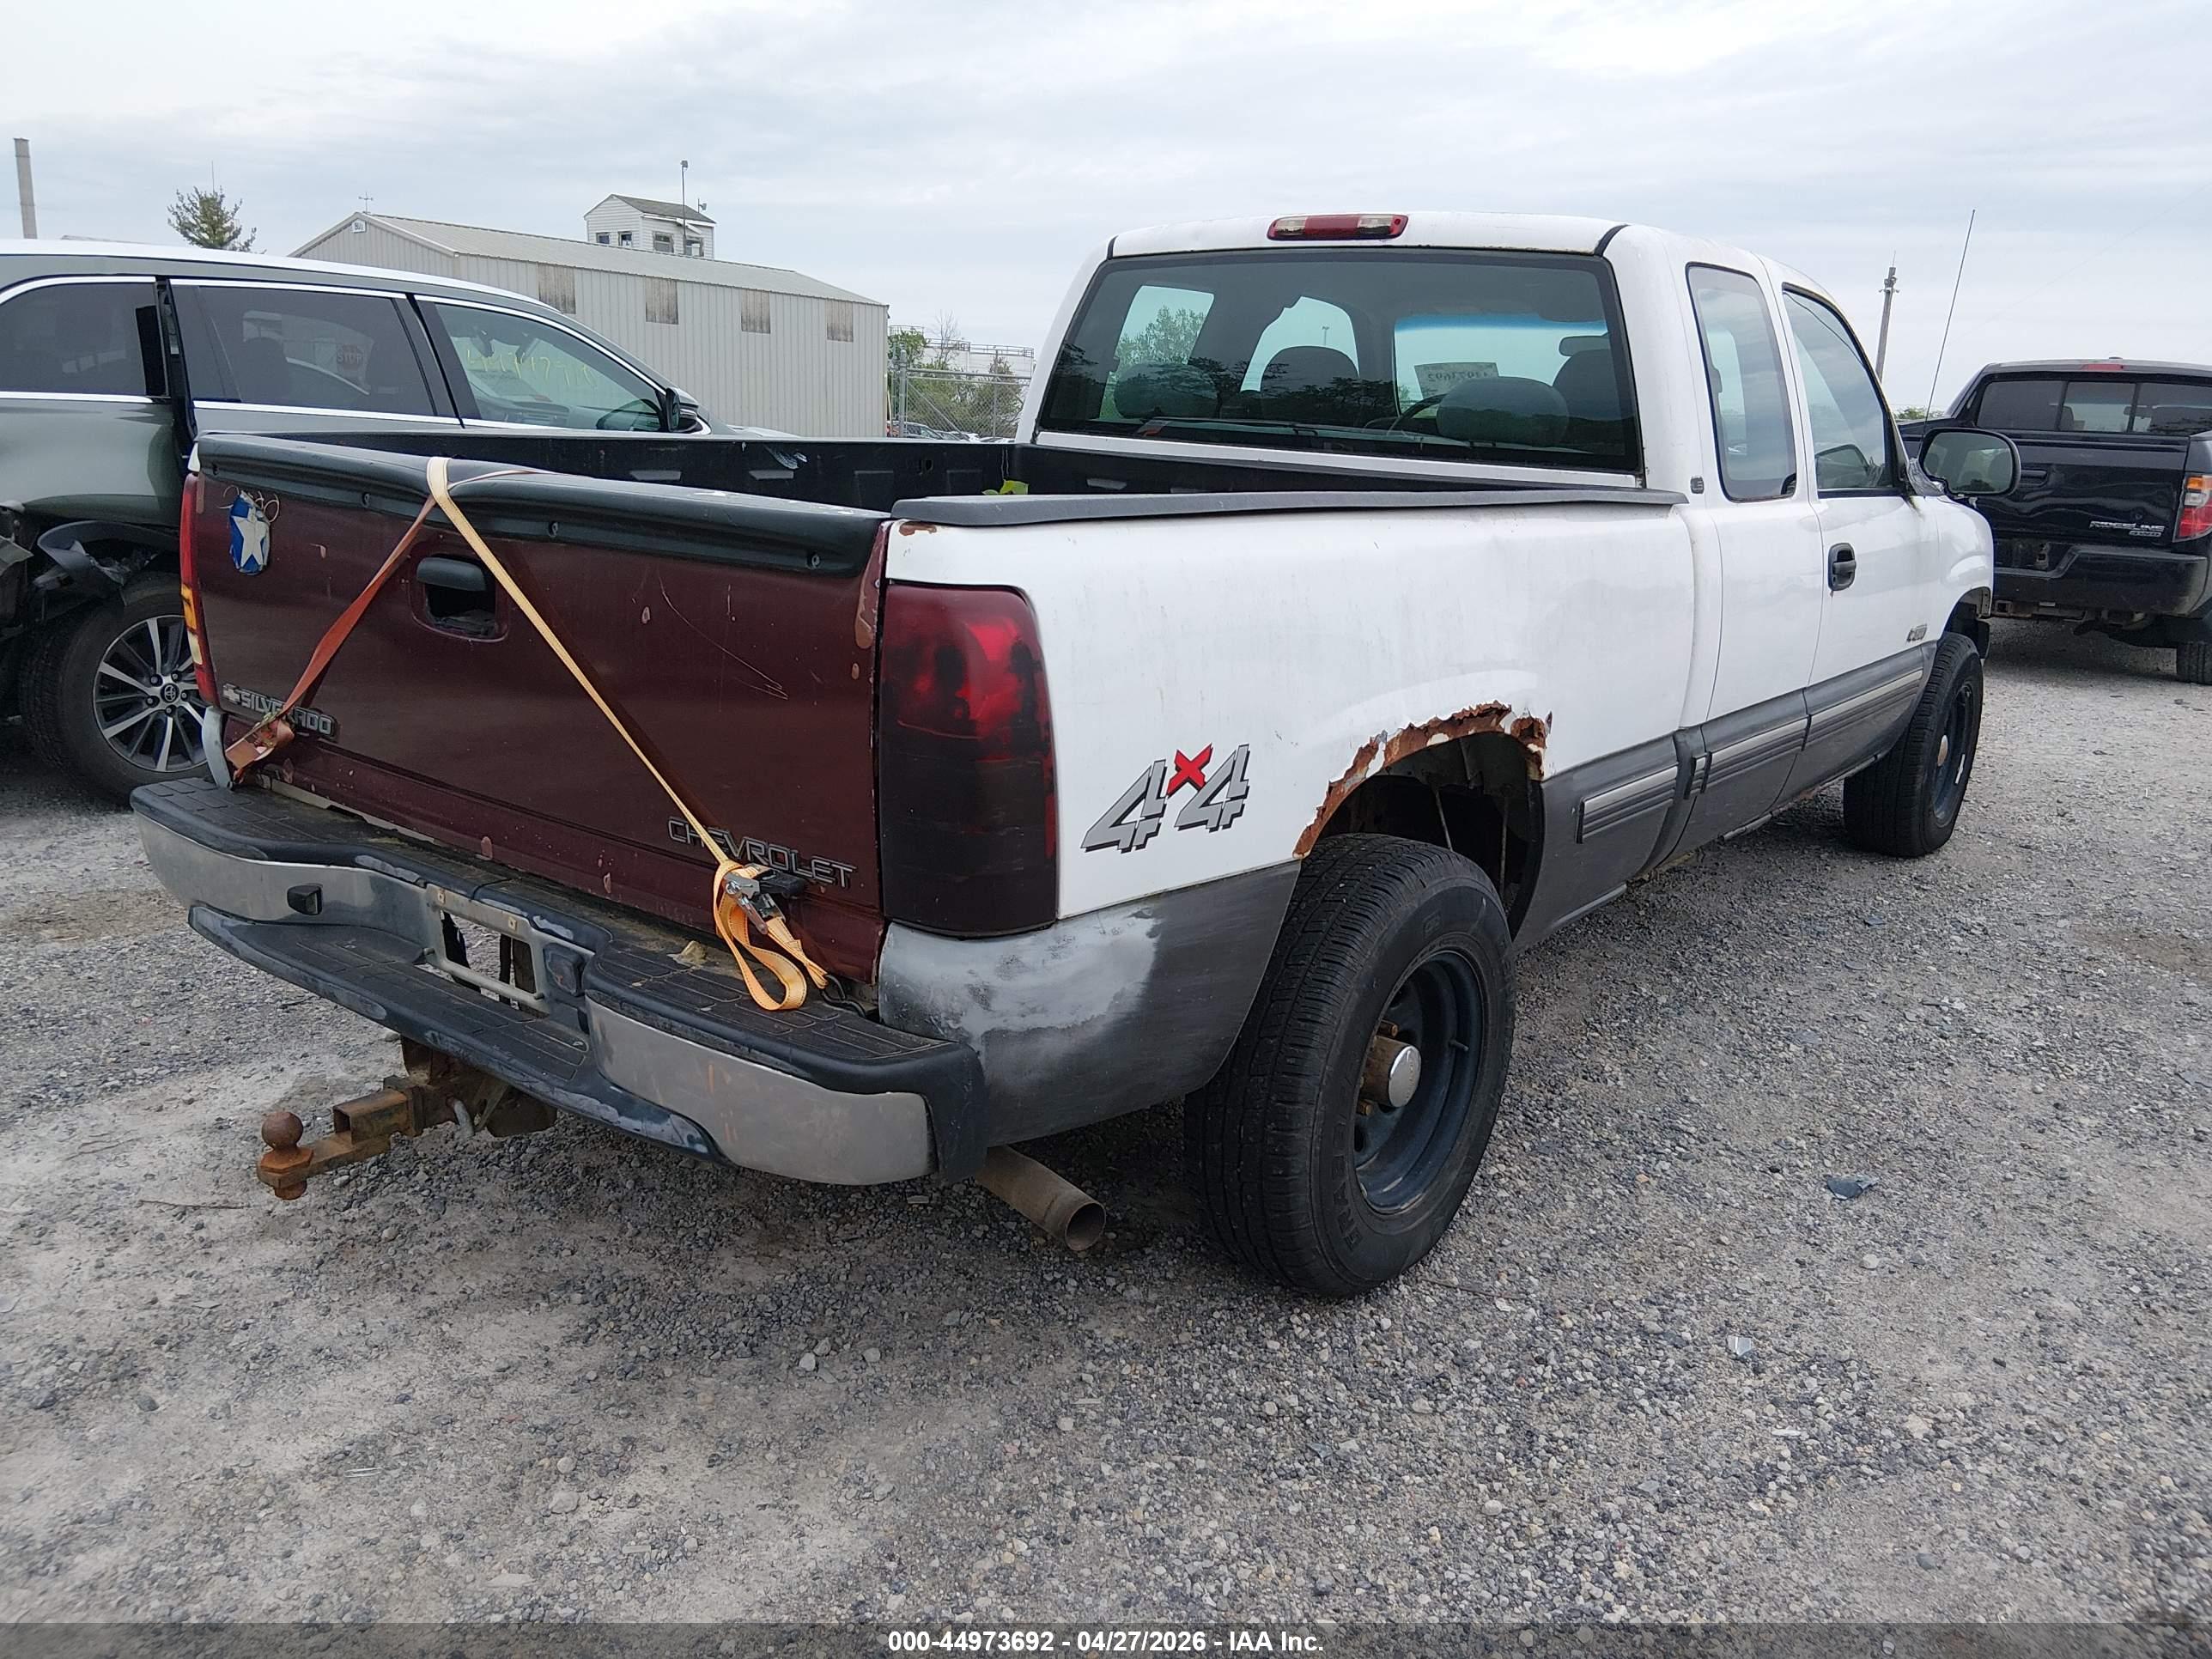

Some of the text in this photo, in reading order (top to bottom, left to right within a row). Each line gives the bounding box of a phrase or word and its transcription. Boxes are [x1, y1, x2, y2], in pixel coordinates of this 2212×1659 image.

[336, 351, 362, 365] STOP
[240, 691, 332, 736] SILVEADO
[667, 817, 858, 889] CHEVROLET
